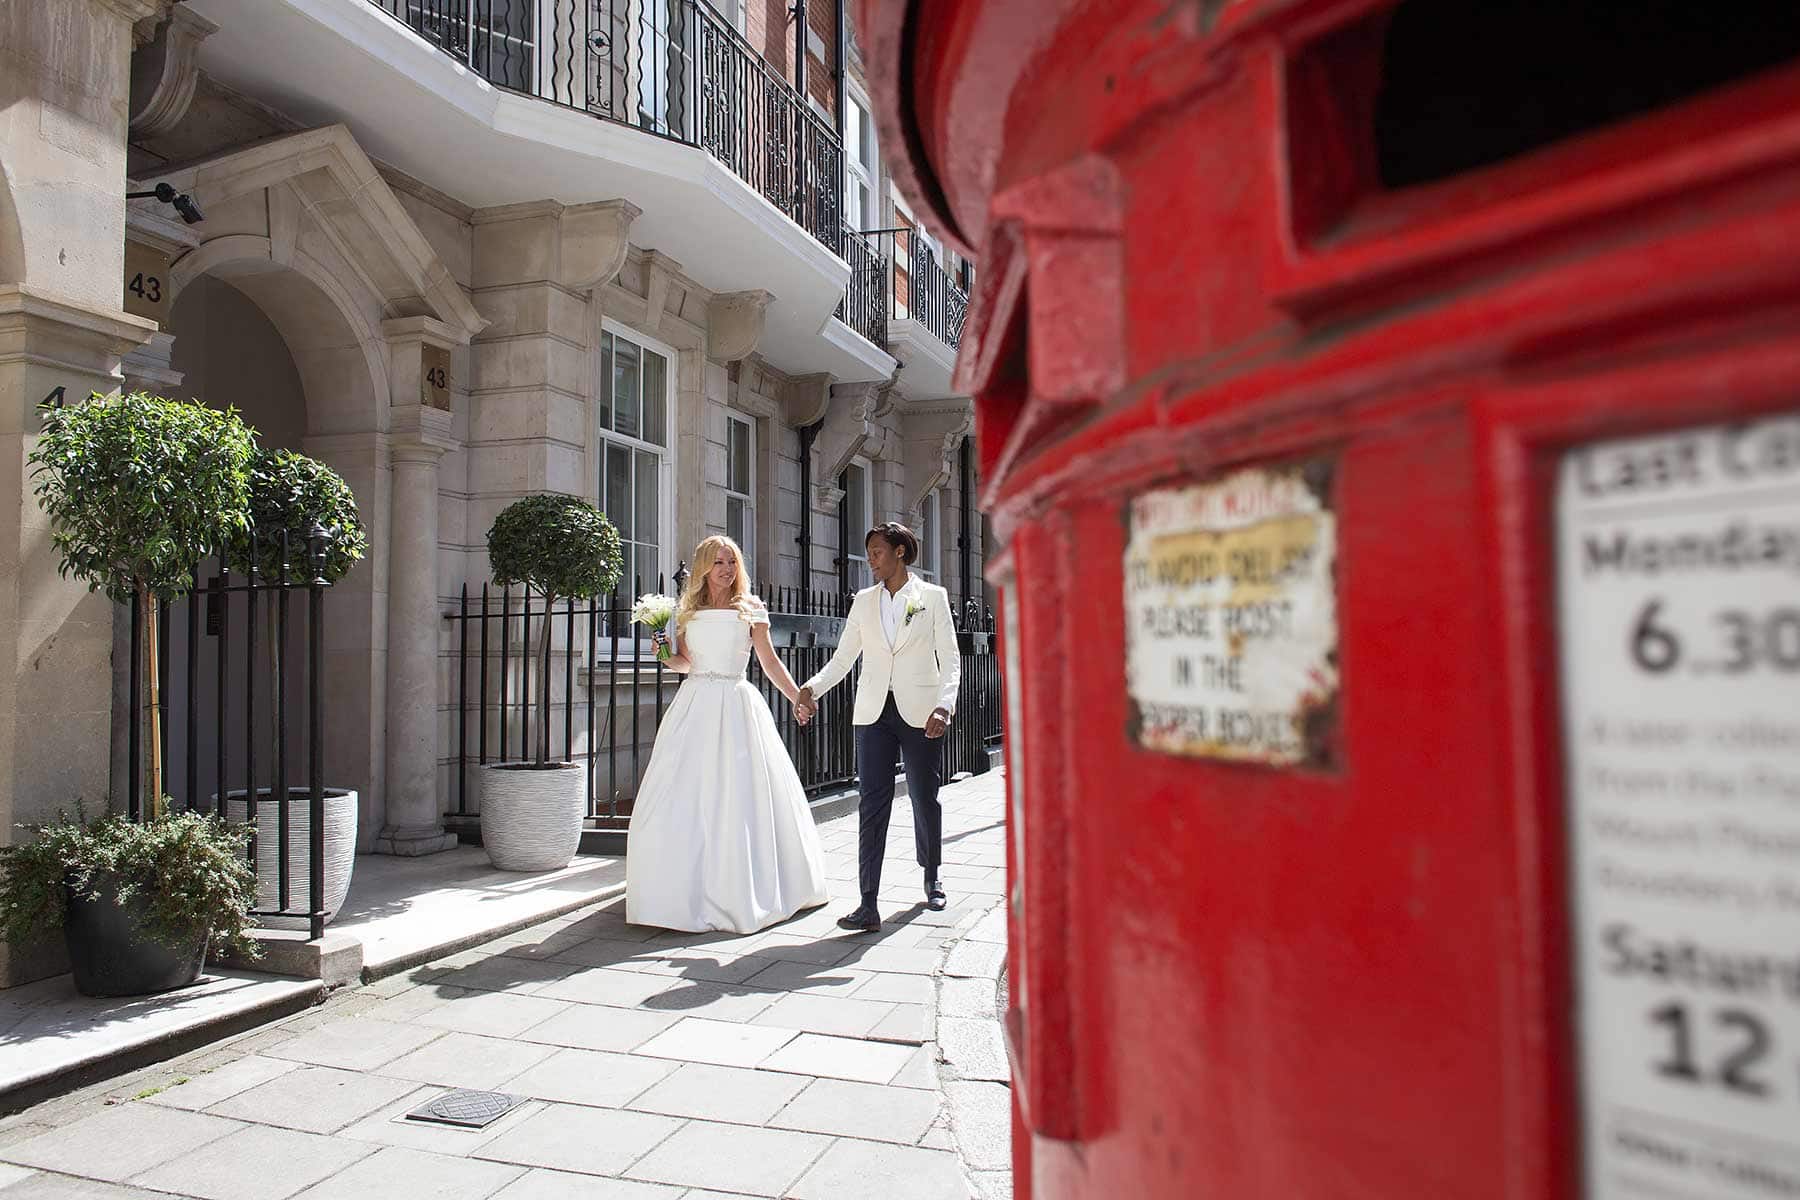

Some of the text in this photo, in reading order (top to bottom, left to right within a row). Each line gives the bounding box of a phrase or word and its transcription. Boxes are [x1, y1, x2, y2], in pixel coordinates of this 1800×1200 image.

[129, 272, 161, 302] 43
[427, 367, 446, 389] 43
[1202, 653, 1244, 694] THE
[1647, 1000, 1775, 1102] 12
